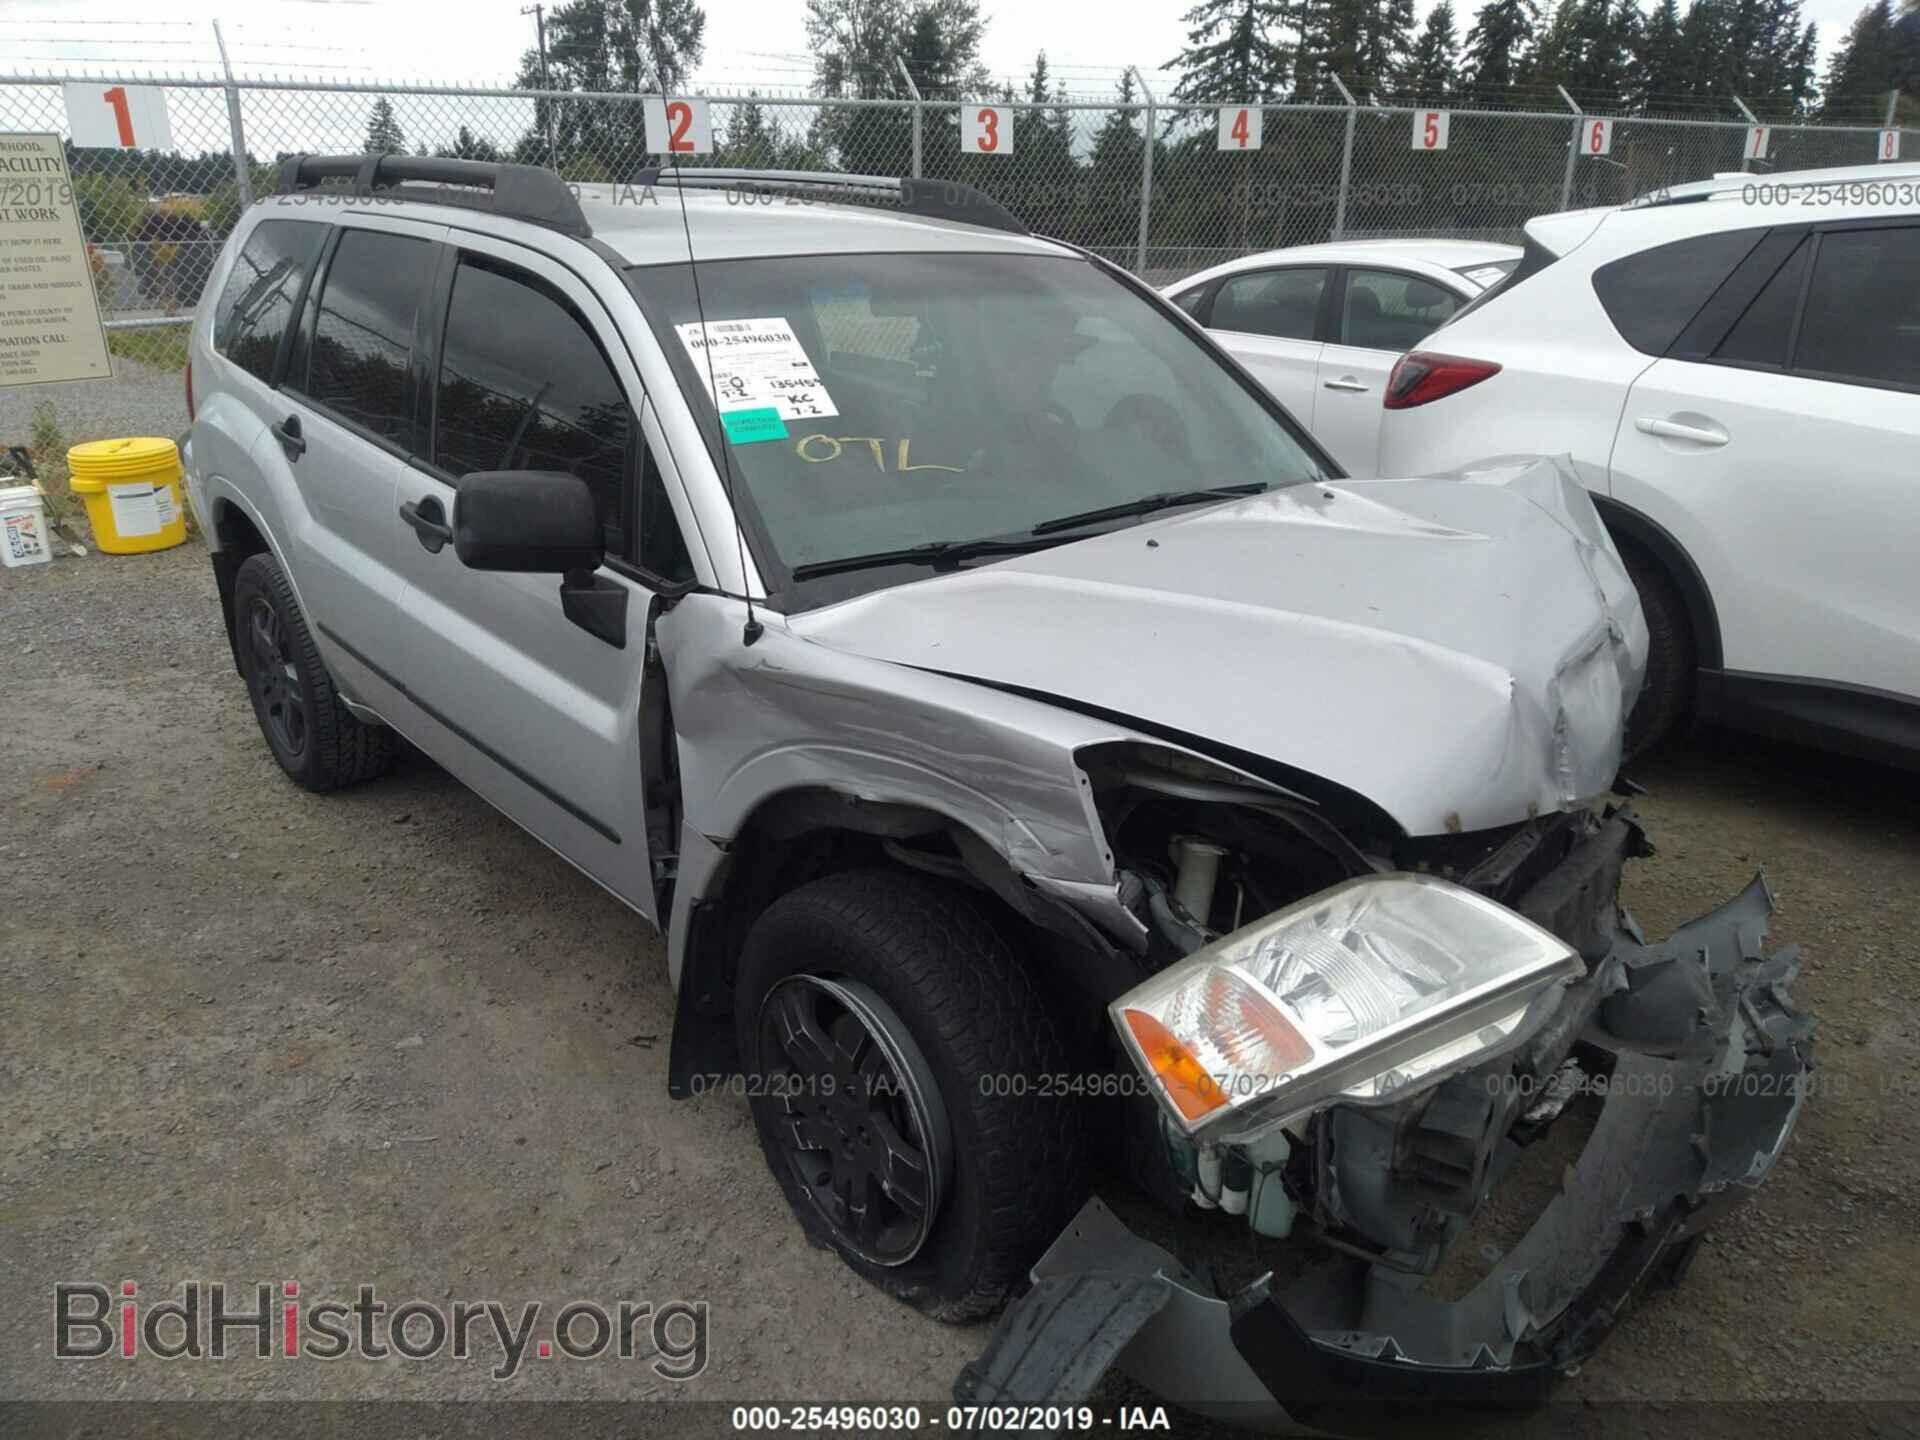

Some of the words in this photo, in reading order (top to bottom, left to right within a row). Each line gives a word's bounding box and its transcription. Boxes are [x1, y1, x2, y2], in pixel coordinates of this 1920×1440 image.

[103, 87, 136, 147] 1
[665, 101, 696, 152] 2
[976, 108, 999, 152] 3
[1231, 109, 1249, 148] 4
[1424, 112, 1439, 148] 5
[1590, 121, 1604, 154] 6
[1753, 128, 1762, 157] 7
[1885, 132, 1894, 158] 8
[15, 208, 60, 220] WORK
